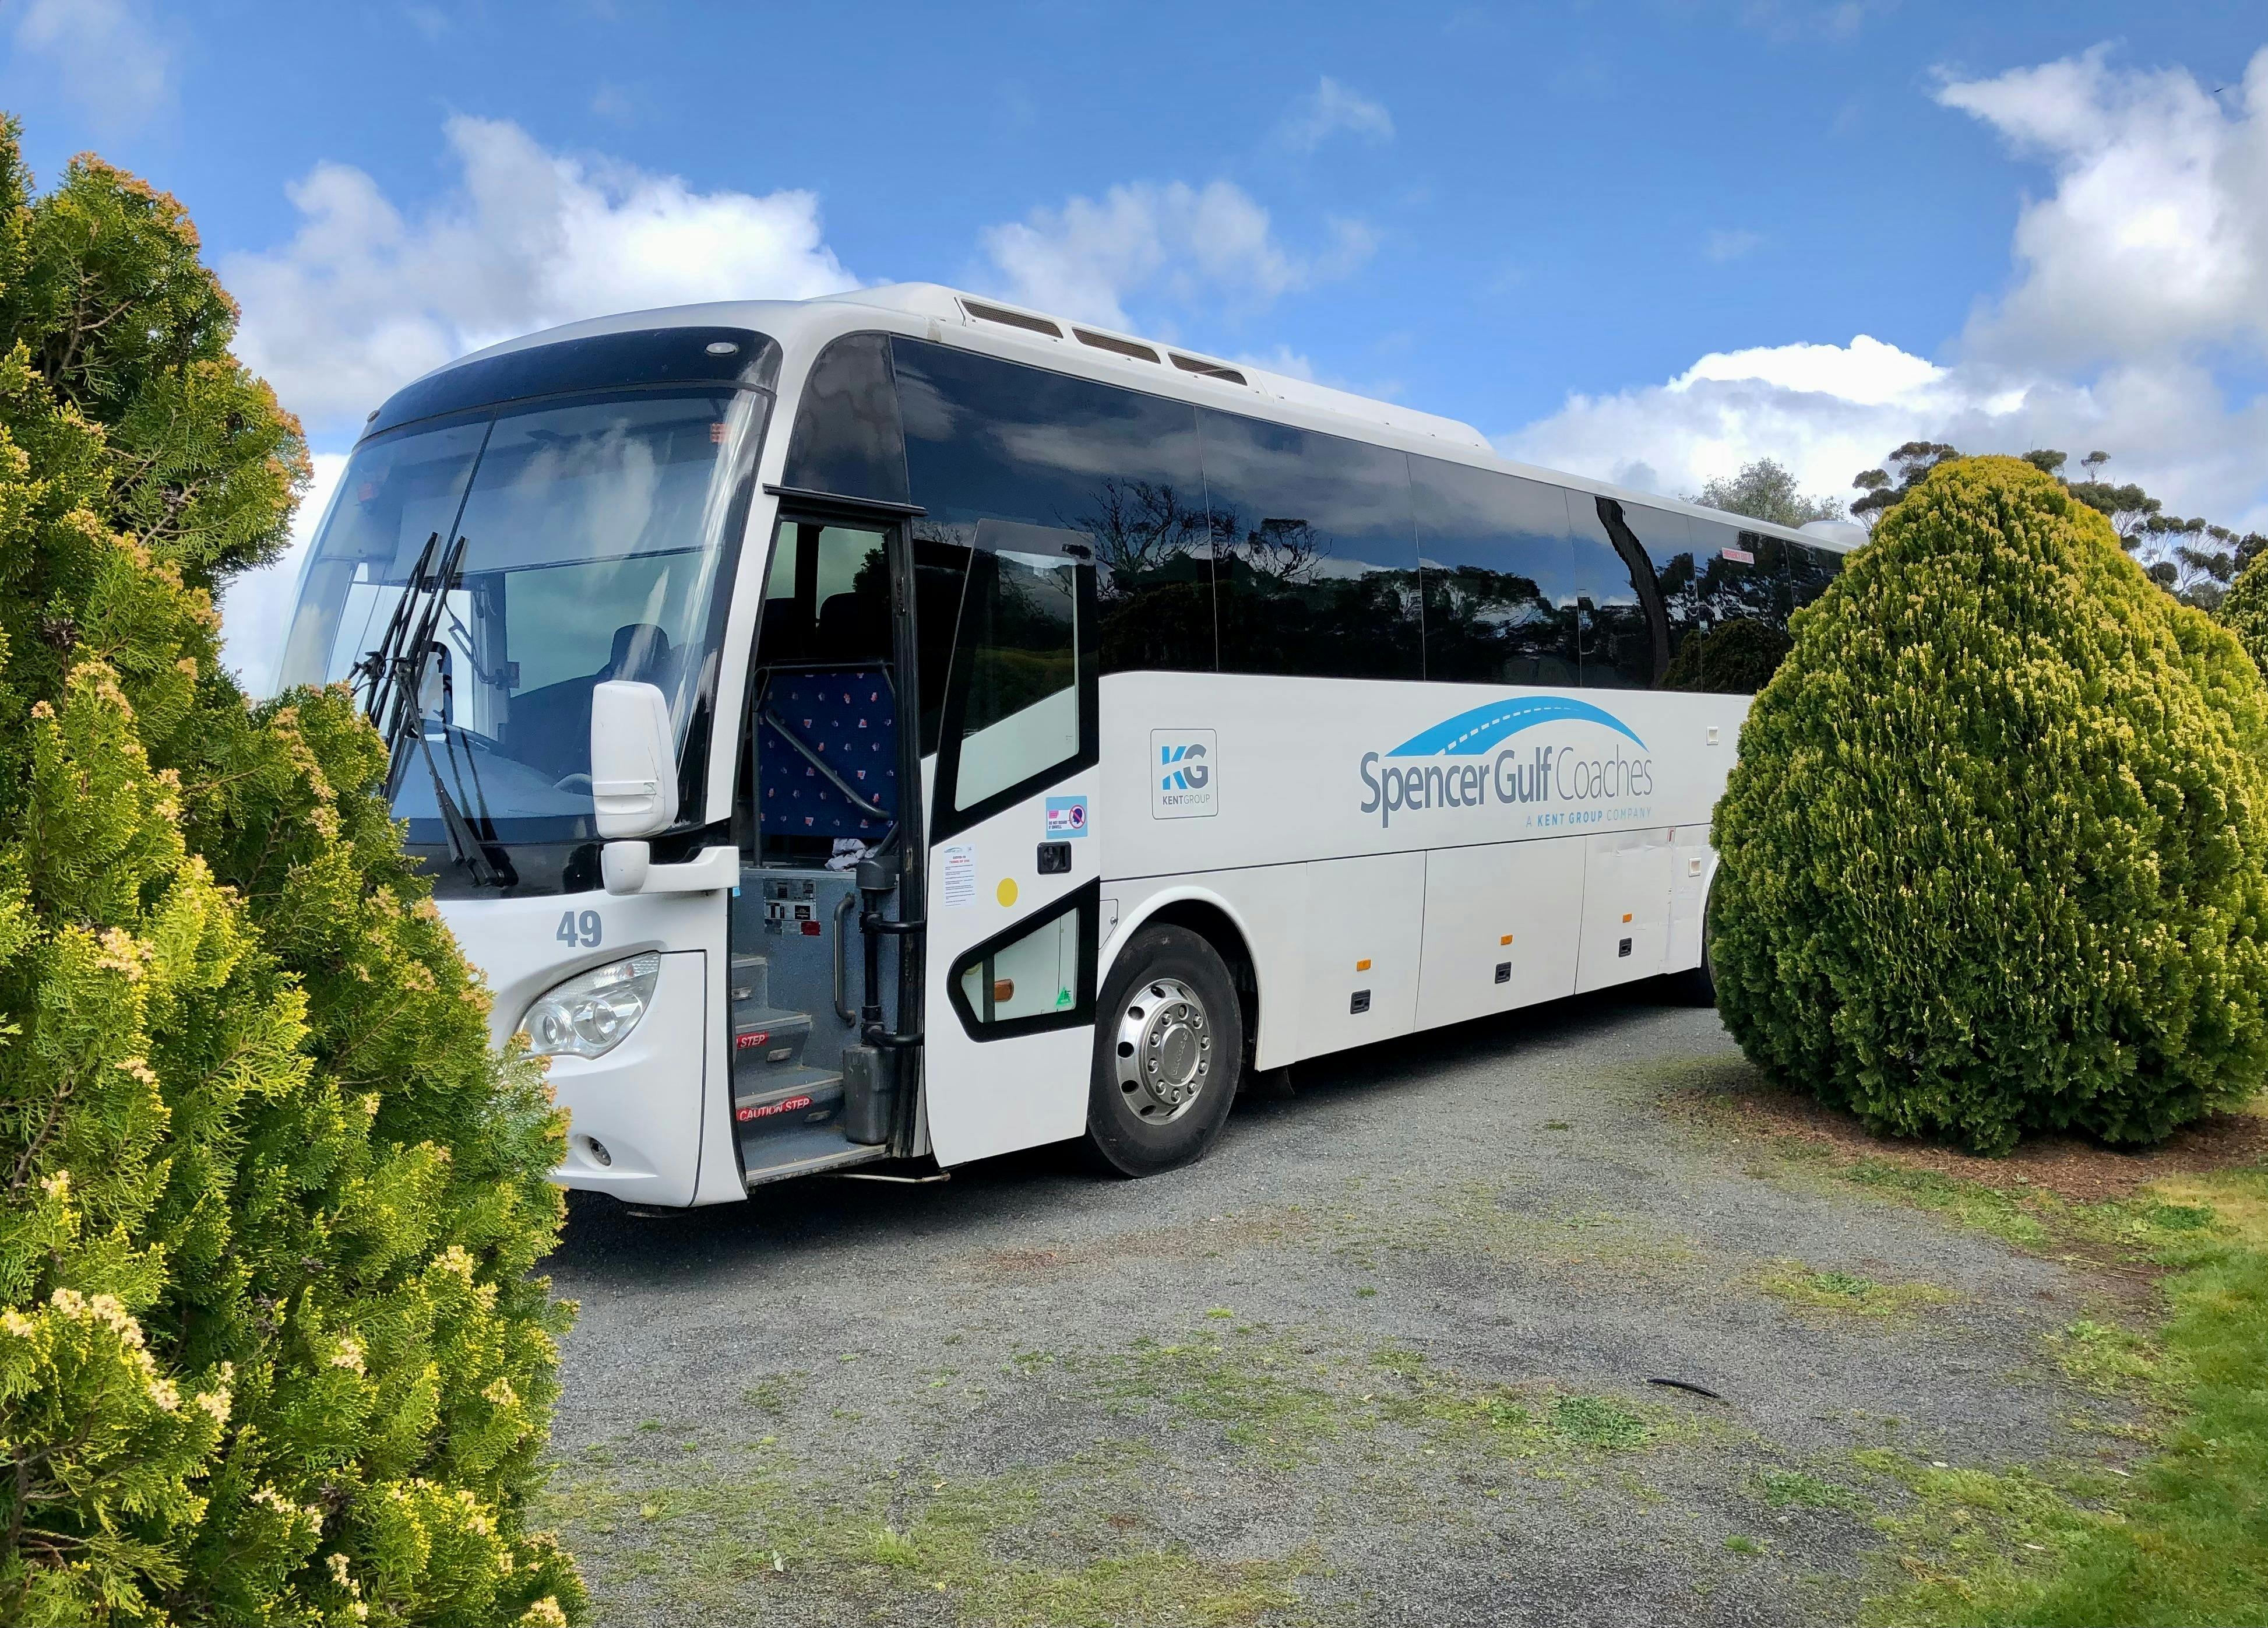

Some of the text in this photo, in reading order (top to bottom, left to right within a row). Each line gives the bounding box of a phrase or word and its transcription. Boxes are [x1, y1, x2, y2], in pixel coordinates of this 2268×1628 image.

[1162, 744, 1208, 790] KG
[1360, 744, 1653, 828] Spencer Gulf Coaches
[1526, 807, 1651, 828] A KENT GROUP COMPANY
[556, 910, 602, 948] 49
[740, 1034, 765, 1047] STEP
[739, 1098, 810, 1121] CAUTION STEP
